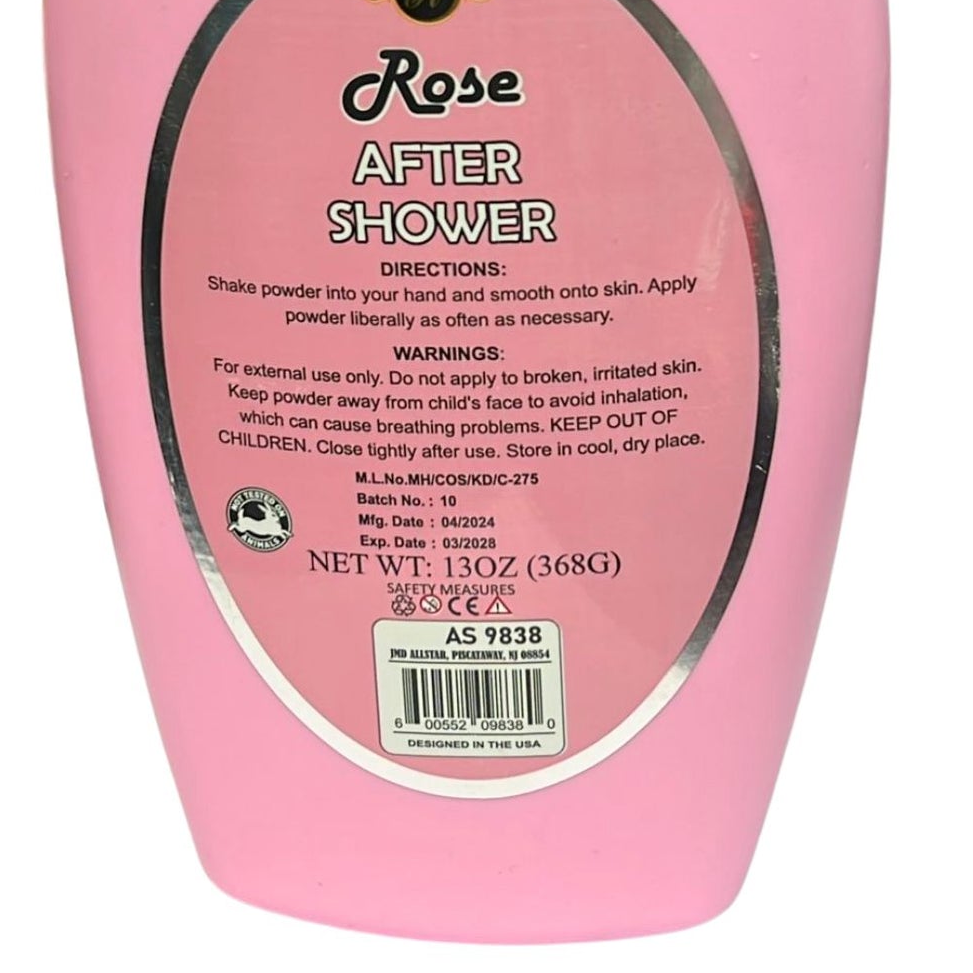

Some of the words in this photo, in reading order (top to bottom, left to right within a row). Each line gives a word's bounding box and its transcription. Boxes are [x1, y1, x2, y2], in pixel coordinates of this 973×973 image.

[341, 47, 523, 122] Rose
[353, 141, 521, 185] AFTER
[327, 199, 557, 244] SHOWER
[380, 261, 507, 277] DIRECTIONS:
[207, 275, 257, 294] Shake
[261, 283, 322, 299] powder
[326, 285, 356, 301] into
[361, 288, 399, 305] your
[404, 287, 446, 302] hand
[452, 287, 484, 302] and
[490, 285, 554, 302] smooth
[559, 284, 598, 299] onto
[603, 280, 643, 297] skin.
[647, 275, 697, 296] Apply
[285, 309, 346, 325] powder
[350, 311, 415, 331] liberally
[420, 315, 440, 327] as
[445, 312, 489, 328] often
[494, 314, 515, 327] as
[520, 309, 614, 326] necessary.
[393, 346, 505, 361] WARNINGS:
[213, 357, 240, 374] For
[243, 362, 307, 381] external
[312, 370, 341, 383] use
[346, 370, 383, 388] only.
[389, 370, 413, 386] Do
[418, 372, 445, 386] not
[450, 370, 496, 388] apply
[502, 372, 518, 385] to
[523, 369, 587, 385] broken,
[593, 362, 657, 381] irritated
[662, 358, 702, 376] skin.
[228, 383, 268, 404] Keep
[273, 389, 332, 407] powder
[337, 398, 380, 412] away
[385, 395, 423, 410] from
[428, 395, 481, 410] child's
[486, 394, 523, 410] face
[528, 395, 544, 408] to
[549, 390, 595, 407] avoid
[601, 385, 688, 405] inhalation,
[239, 410, 284, 427] which
[289, 415, 318, 429] can
[323, 418, 371, 432] cause
[376, 419, 455, 438] breathing
[461, 419, 545, 437] problems.
[550, 415, 602, 432] KEEP
[606, 411, 647, 429] OUT
[651, 409, 678, 425] OF
[218, 429, 312, 453] CHILDREN.
[316, 439, 363, 456] Close
[368, 443, 417, 461] tightly
[422, 444, 460, 459] after
[465, 447, 501, 459] use.
[506, 443, 552, 458] Store
[557, 441, 572, 457] in
[577, 439, 618, 455] cool,
[622, 437, 650, 454] dry
[655, 432, 705, 451] place.
[231, 495, 245, 511] NOT
[243, 490, 276, 506] TESTED
[274, 504, 286, 517] ON
[356, 493, 398, 507] Batch
[400, 495, 425, 507] No.
[440, 495, 457, 507] 10
[358, 514, 388, 528] Mfg.
[392, 515, 424, 528] Date
[441, 516, 495, 528] 04/2024
[240, 534, 281, 549] ANIMALS
[359, 534, 391, 550] Exp.
[394, 536, 426, 549] Date
[442, 537, 496, 549] 03/2028
[307, 549, 369, 575] NET
[376, 553, 432, 577] WT:
[444, 556, 519, 578] 13OZ
[526, 551, 622, 582] (368G)
[387, 582, 436, 595] SAFETY
[440, 584, 515, 595] MEASURES
[445, 627, 477, 645] AS
[484, 626, 543, 644] 9838
[394, 718, 403, 729] 6
[425, 719, 467, 731] 00552
[481, 719, 524, 731] 09838
[547, 718, 556, 729] 0
[407, 739, 470, 749] DESIGNED
[472, 740, 485, 749] IN
[488, 740, 512, 749] THE
[515, 739, 541, 749] USA
